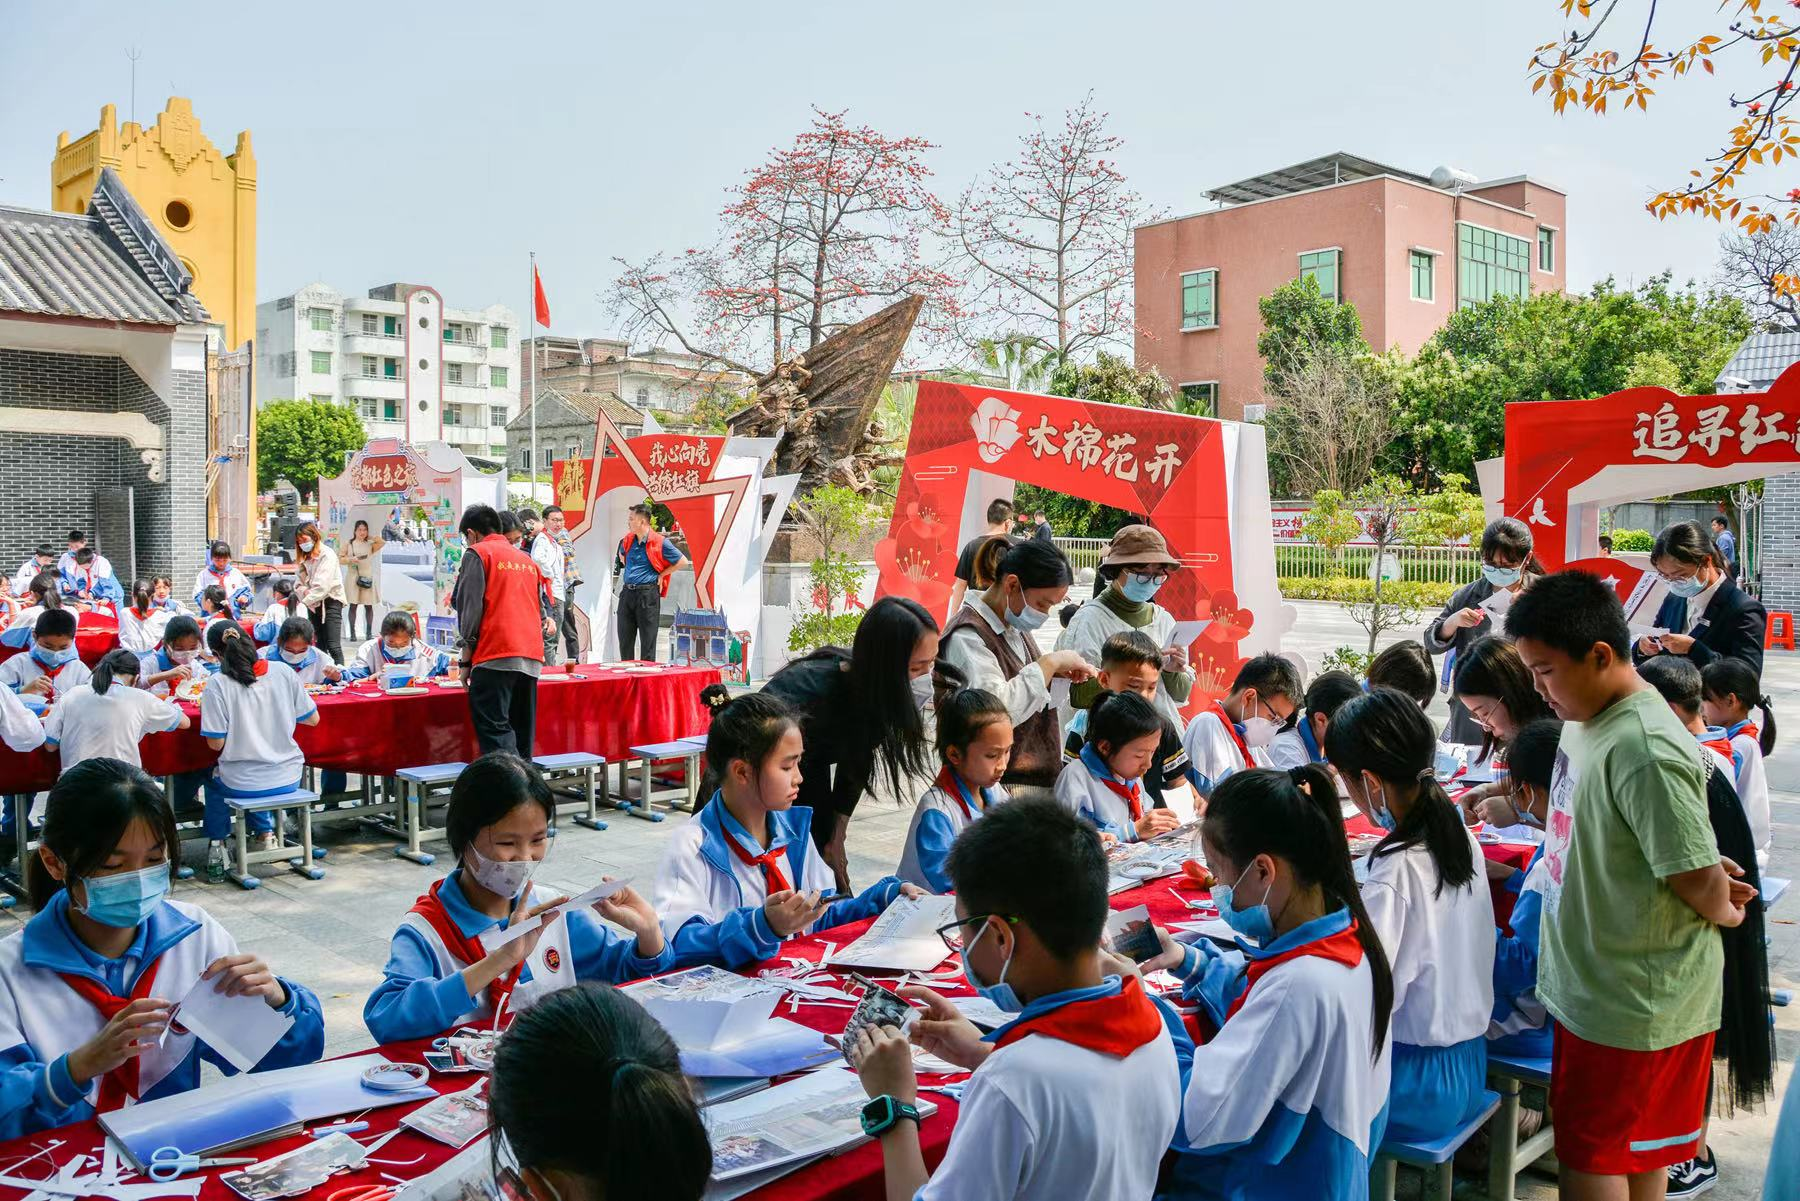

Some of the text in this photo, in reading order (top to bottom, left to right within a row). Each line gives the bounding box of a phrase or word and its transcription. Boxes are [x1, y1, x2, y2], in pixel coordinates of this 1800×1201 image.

[649, 438, 711, 469] 我心向党
[1026, 414, 1183, 489] 木棉花开
[1632, 402, 1800, 462] 追寻红
